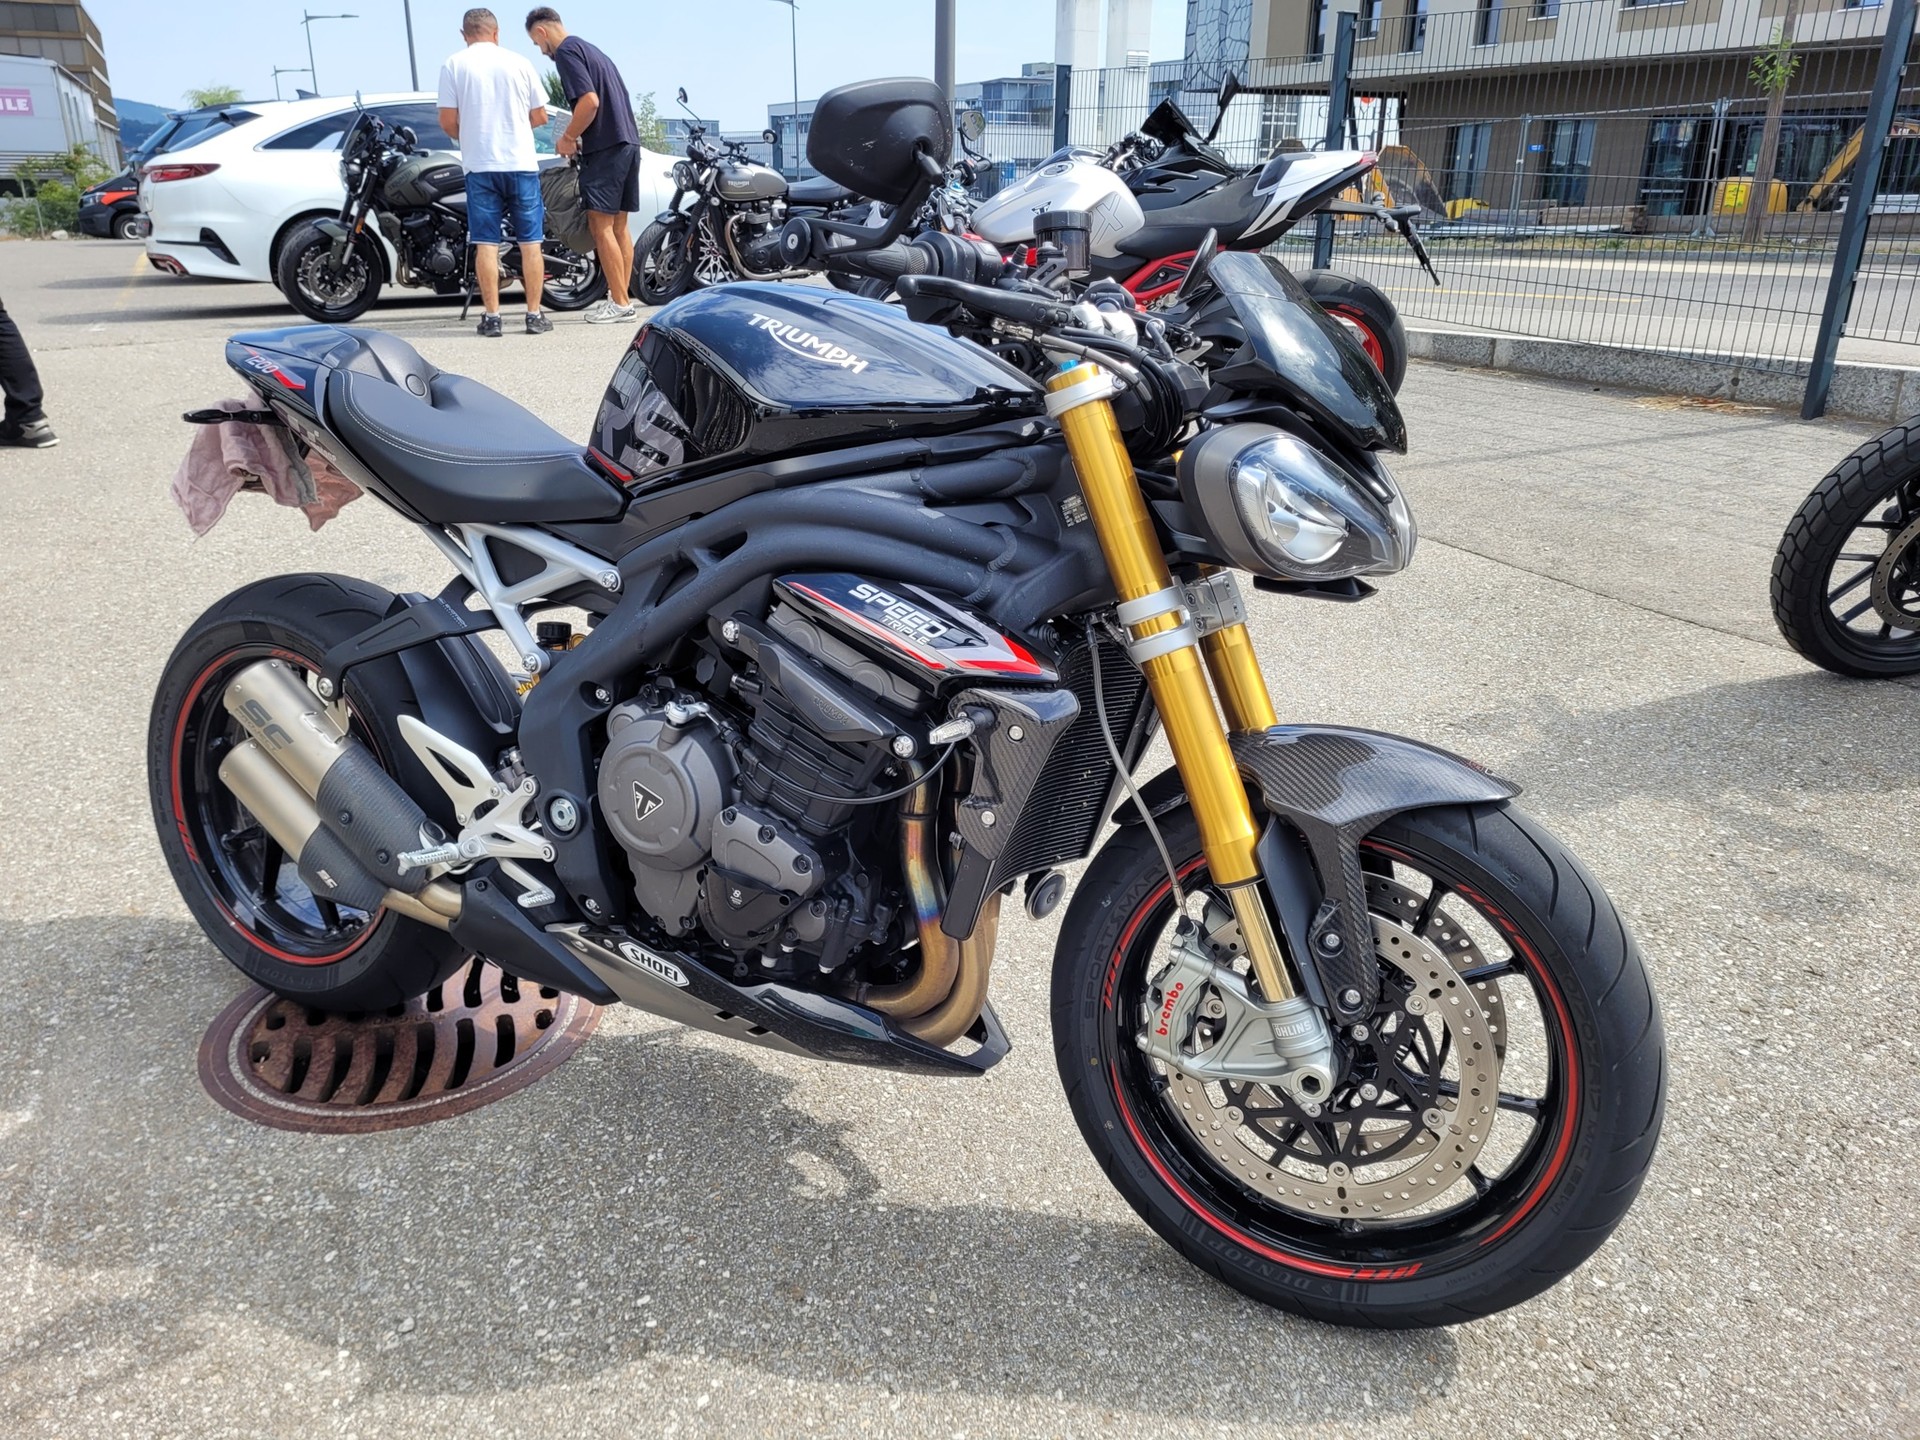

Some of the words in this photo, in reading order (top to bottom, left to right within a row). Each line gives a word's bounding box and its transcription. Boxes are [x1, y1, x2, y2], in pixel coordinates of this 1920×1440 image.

[245, 356, 279, 373] 1200
[748, 313, 869, 374] TRIUMPH
[848, 583, 948, 638] SPEED
[881, 615, 931, 645] TRIPLE
[239, 699, 294, 749] SC
[813, 695, 849, 725] TRIUMPH
[1084, 860, 1168, 1019] SPORTSMAR
[630, 948, 678, 982] SHOEI
[1155, 982, 1184, 1036] brembo
[1208, 1239, 1313, 1290] DUNLOP
